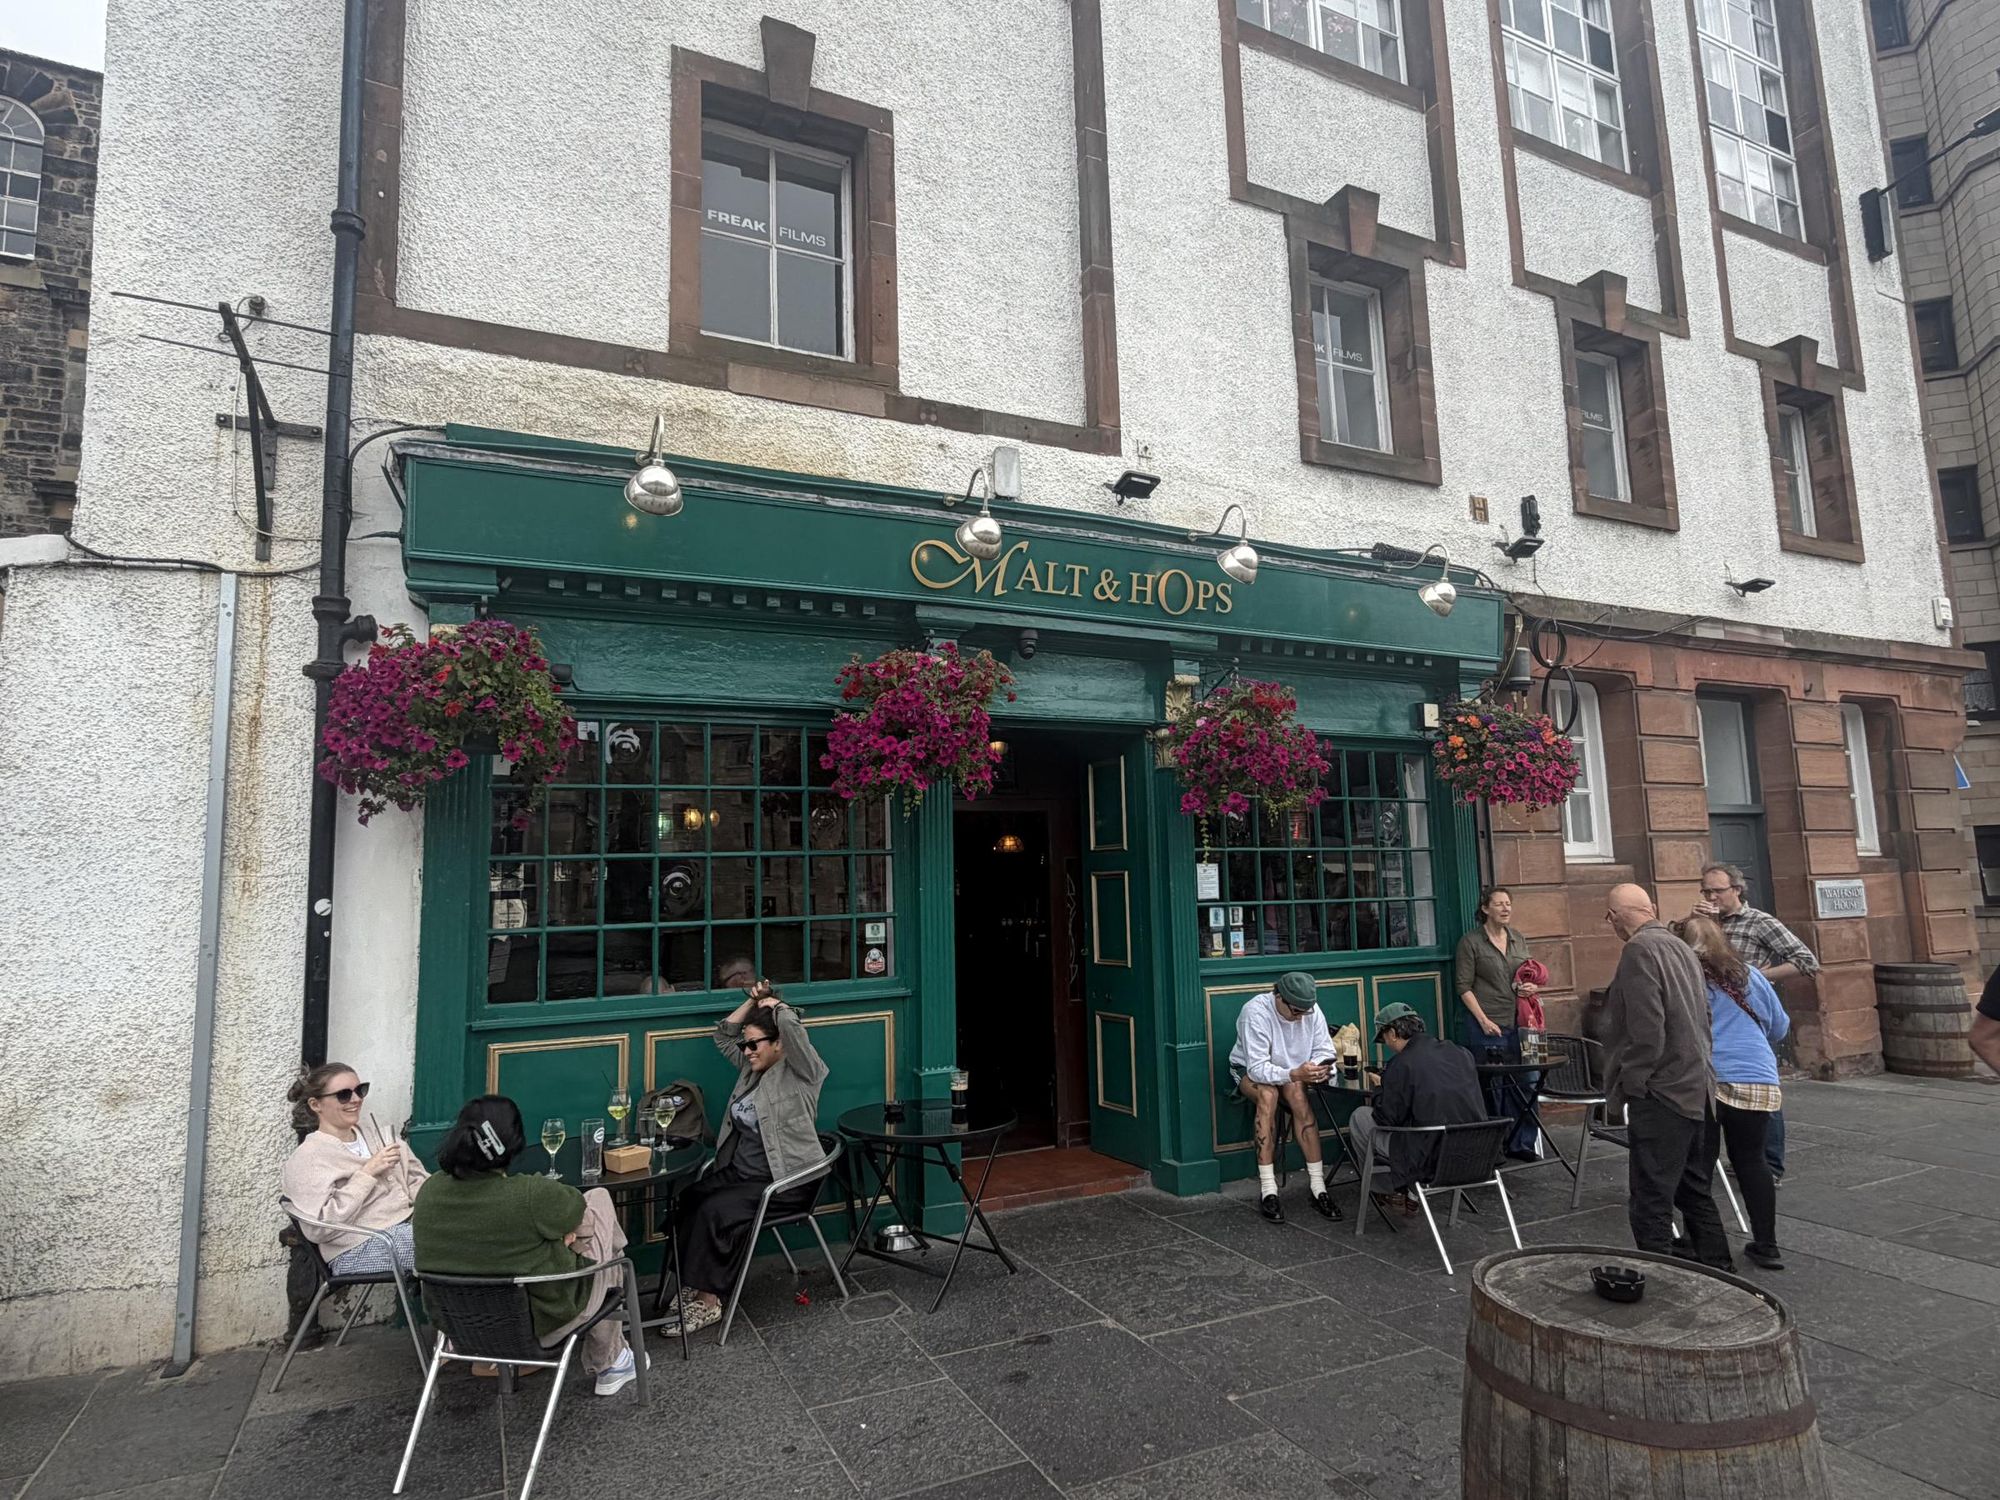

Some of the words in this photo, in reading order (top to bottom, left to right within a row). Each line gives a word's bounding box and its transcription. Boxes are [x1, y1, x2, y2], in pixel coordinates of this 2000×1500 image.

[707, 209, 767, 233] FREAK
[779, 226, 827, 248] FILMS
[1332, 347, 1363, 362] FILMS
[910, 539, 1089, 598] MALT
[1093, 568, 1122, 603] &
[1127, 568, 1234, 616] HOPS
